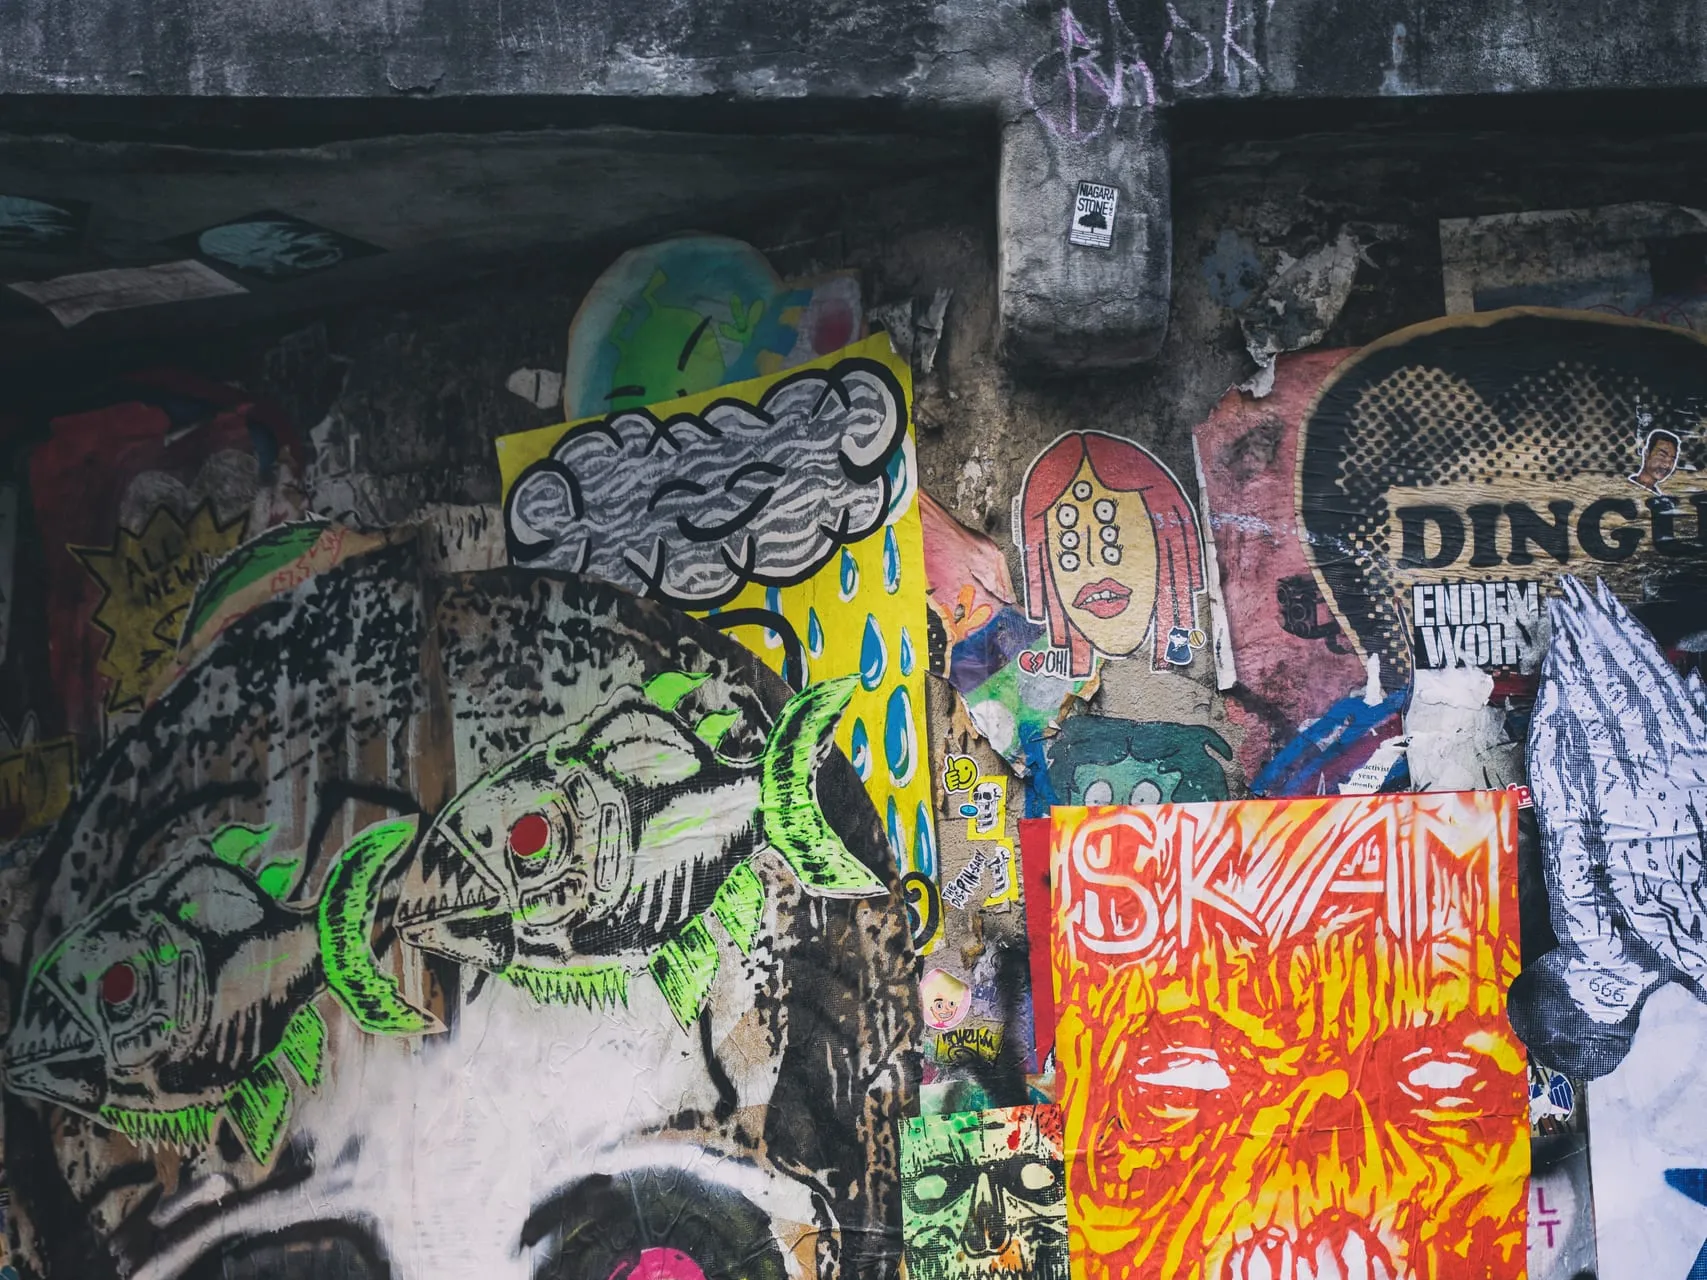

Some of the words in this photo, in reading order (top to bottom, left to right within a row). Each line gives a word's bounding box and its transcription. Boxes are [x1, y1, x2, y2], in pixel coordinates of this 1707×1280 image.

[1079, 184, 1114, 201] NIAGARA
[1077, 198, 1109, 215] STONE
[126, 537, 182, 590] ALL
[1046, 650, 1068, 676] OH!
[1073, 800, 1500, 954] SKAM
[942, 882, 957, 899] THE
[1589, 976, 1627, 1003] 666
